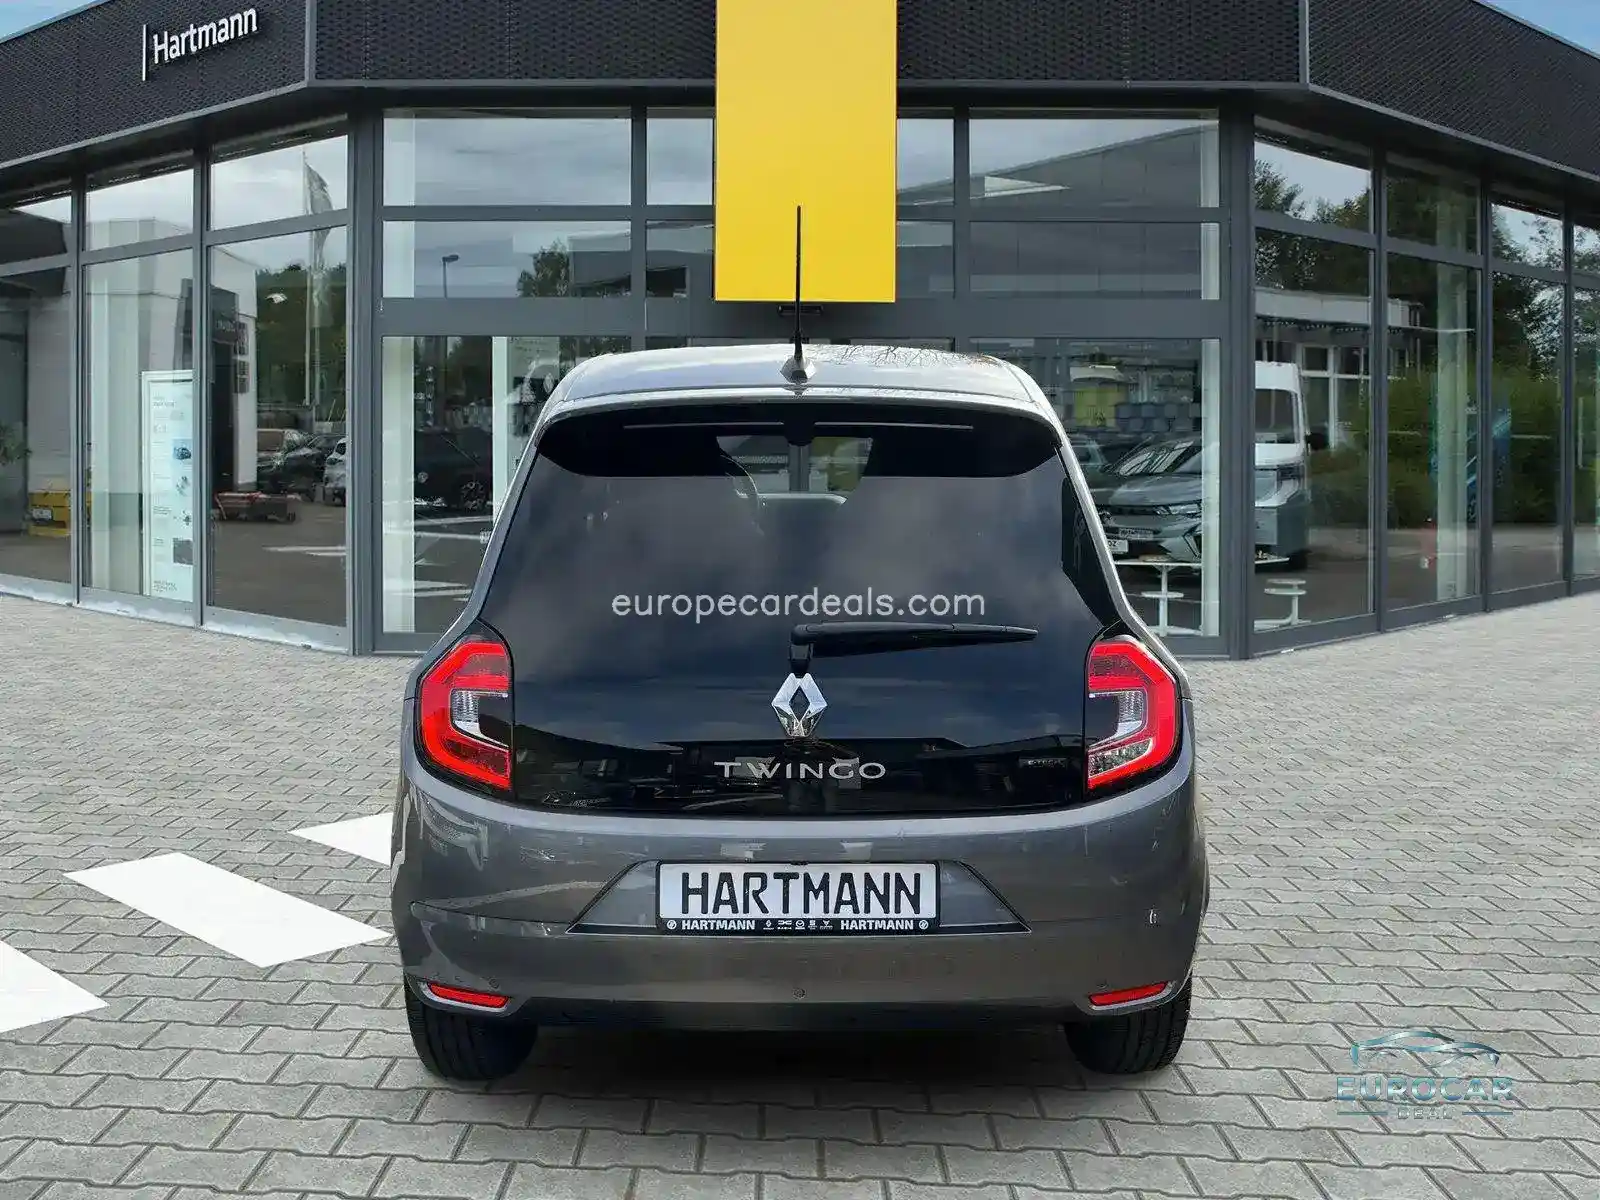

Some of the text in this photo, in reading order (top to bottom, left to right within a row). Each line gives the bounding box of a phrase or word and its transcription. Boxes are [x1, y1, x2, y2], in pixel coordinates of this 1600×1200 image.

[152, 8, 258, 64] Hartmann
[713, 761, 887, 779] TWINGO
[681, 872, 921, 915] HARTMANN
[681, 919, 756, 931] HARTMANN
[840, 919, 914, 931] HARTMANN
